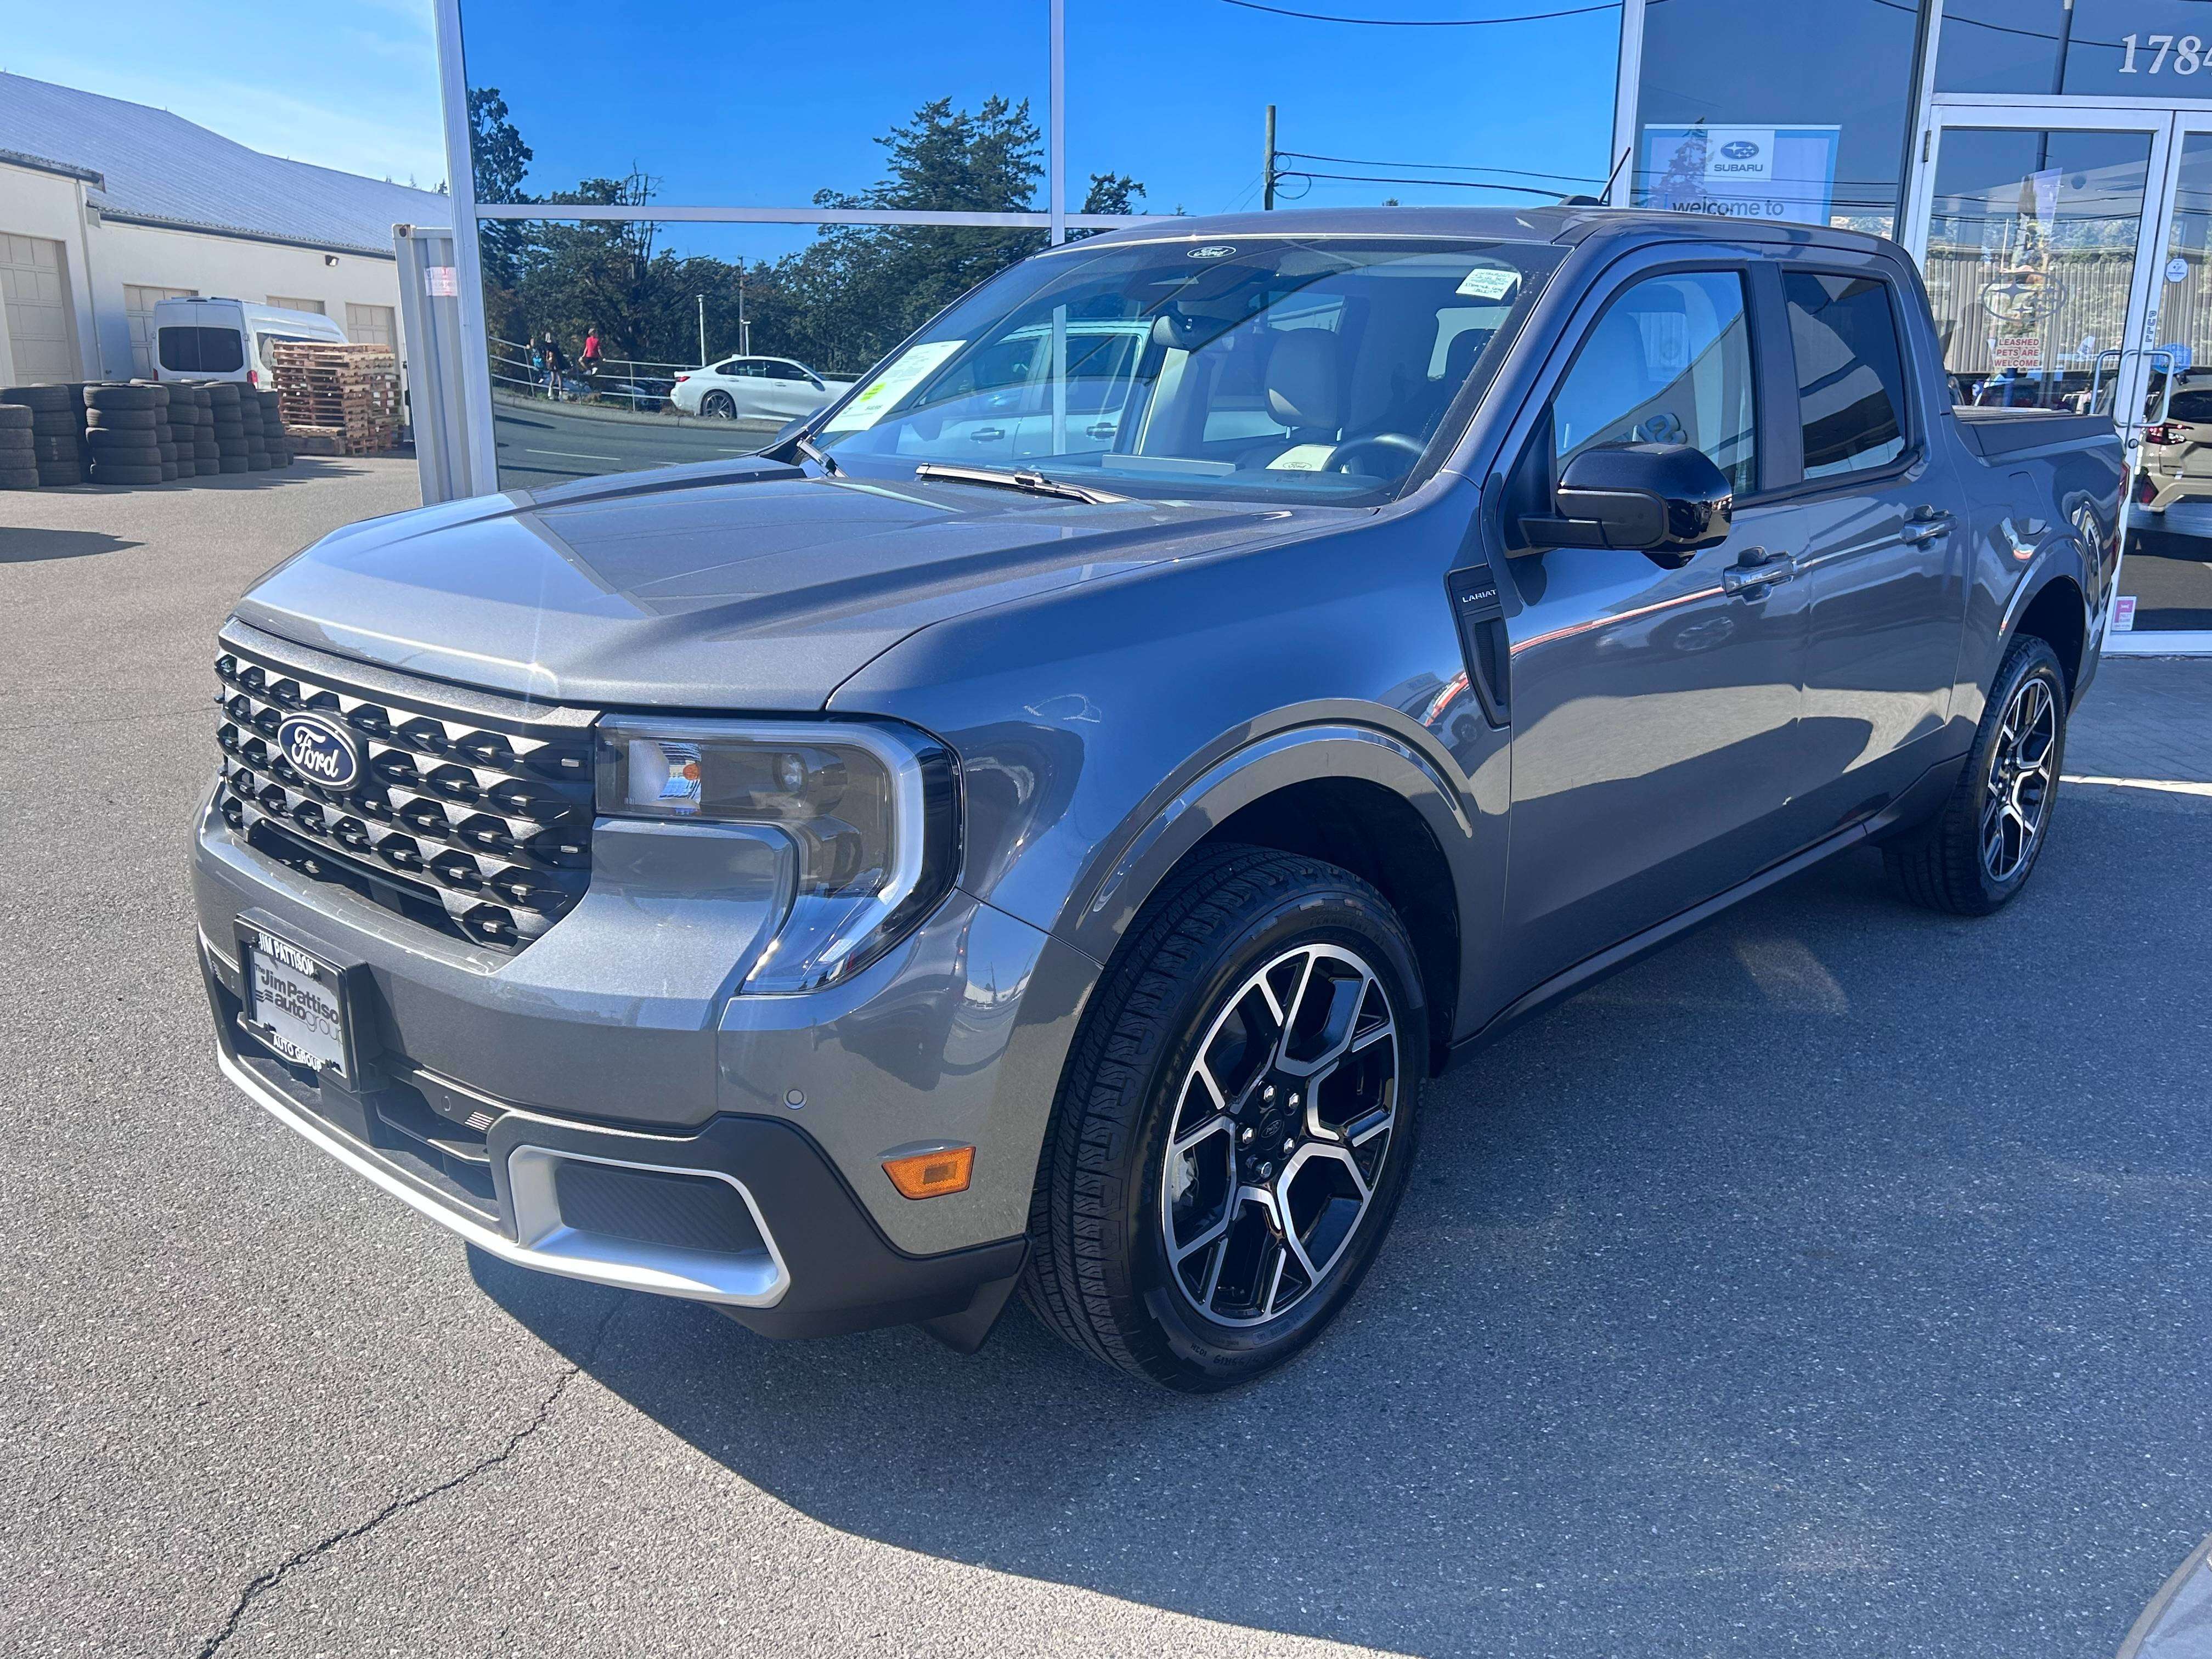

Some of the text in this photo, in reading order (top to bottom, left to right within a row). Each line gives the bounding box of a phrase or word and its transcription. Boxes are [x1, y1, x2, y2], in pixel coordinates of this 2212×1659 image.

[1714, 164, 1764, 172] SUBARU
[1672, 196, 1784, 216] welcome to
[2145, 310, 2157, 343] PULL
[1999, 338, 2040, 346] LEASHED
[1994, 359, 2039, 367] WELCOME
[1462, 589, 1497, 603] LARIAT
[291, 725, 340, 778] Ford
[258, 932, 315, 976] JIM PATTISON
[273, 1035, 323, 1073] AUTO GROUP
